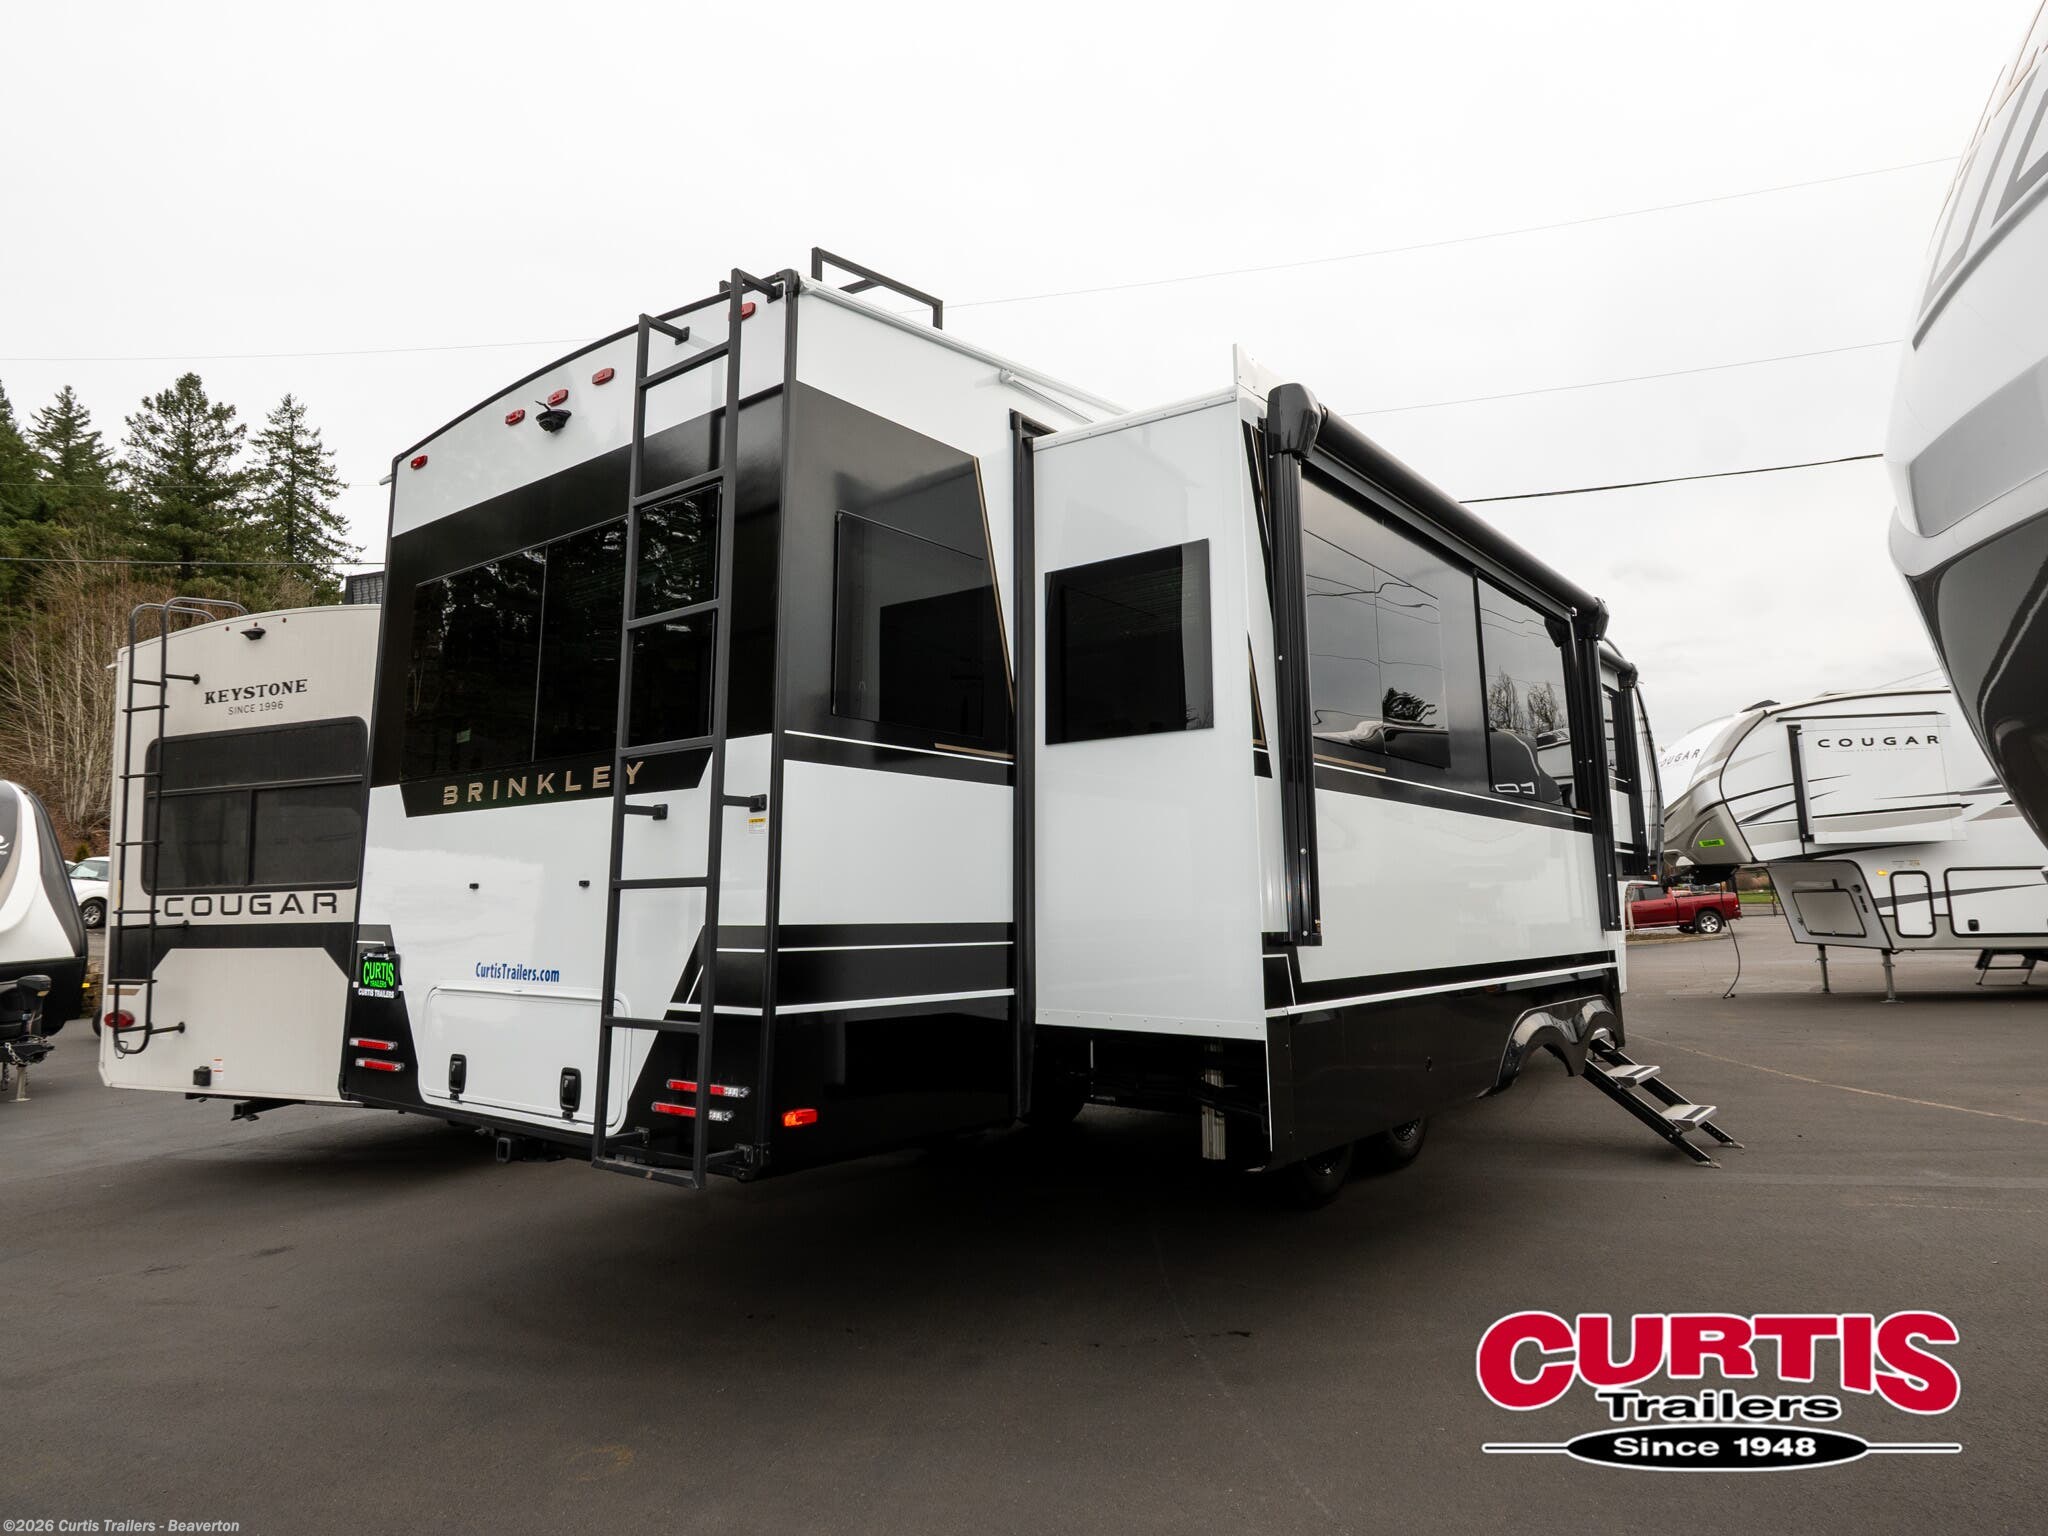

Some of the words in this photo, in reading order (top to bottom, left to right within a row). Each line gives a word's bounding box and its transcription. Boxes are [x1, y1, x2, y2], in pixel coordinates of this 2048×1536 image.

[204, 679, 308, 704] KEYSTONE
[228, 704, 256, 715] SINCE
[259, 701, 284, 712] 1996
[1817, 735, 1940, 748] COUGAR
[443, 761, 644, 806] BRINKLEY
[164, 892, 337, 917] COUGAR
[363, 961, 394, 987] CURTIS
[475, 962, 560, 983] CurtisTrailers.com
[358, 988, 374, 997] CURTIS
[375, 989, 395, 999] TRAILERS
